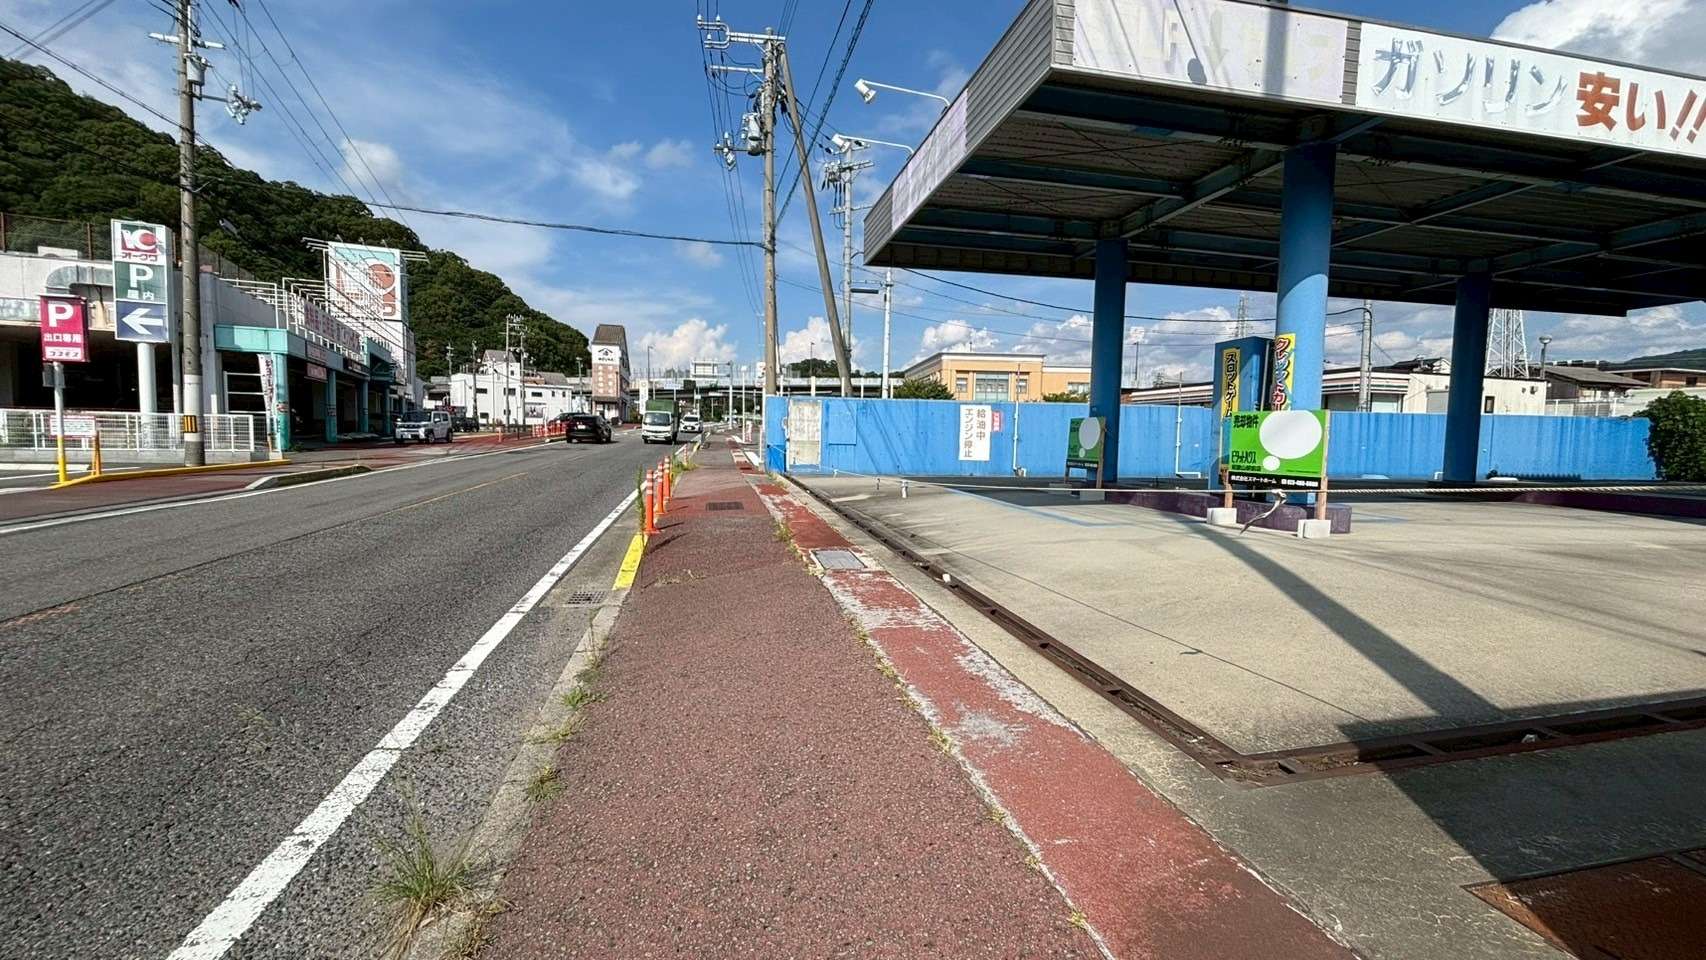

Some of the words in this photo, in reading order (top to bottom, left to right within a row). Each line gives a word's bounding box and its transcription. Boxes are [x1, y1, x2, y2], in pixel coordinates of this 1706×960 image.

[121, 252, 158, 262] オークワ
[129, 263, 154, 288] P
[48, 300, 74, 328] P
[964, 408, 974, 458] エンジン停止
[976, 408, 986, 440] 給油中
